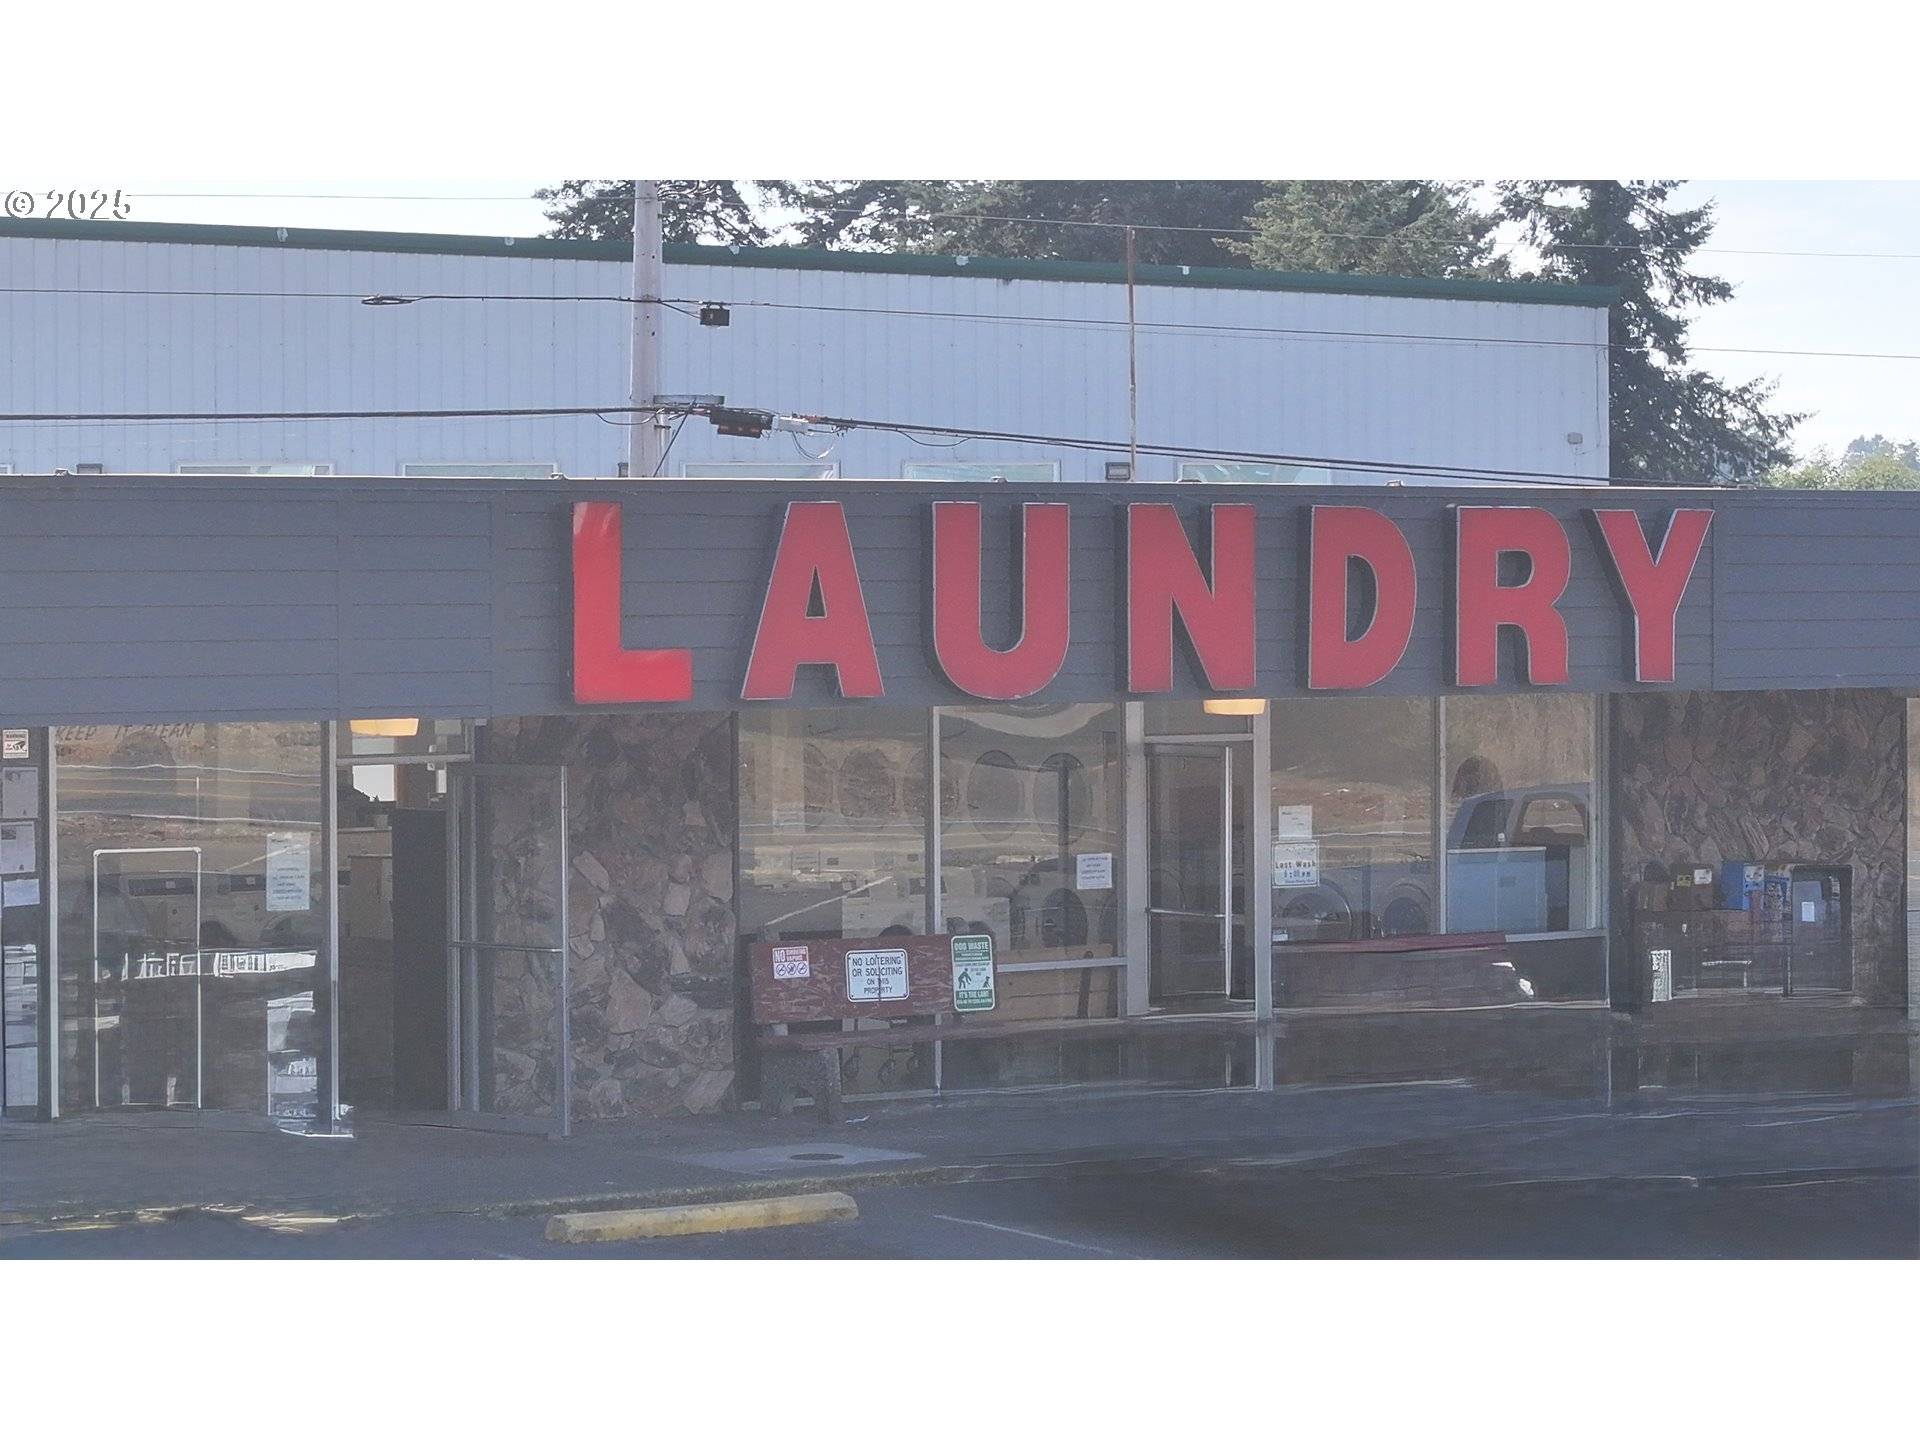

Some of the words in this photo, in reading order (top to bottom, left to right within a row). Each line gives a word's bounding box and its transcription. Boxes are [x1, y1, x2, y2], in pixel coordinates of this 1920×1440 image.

[572, 499, 1715, 704] LAUNDRY
[55, 725, 97, 741] KEEP
[774, 949, 786, 962] NO
[852, 957, 863, 967] NO
[865, 955, 902, 966] LOITERING
[852, 968, 863, 977] OR
